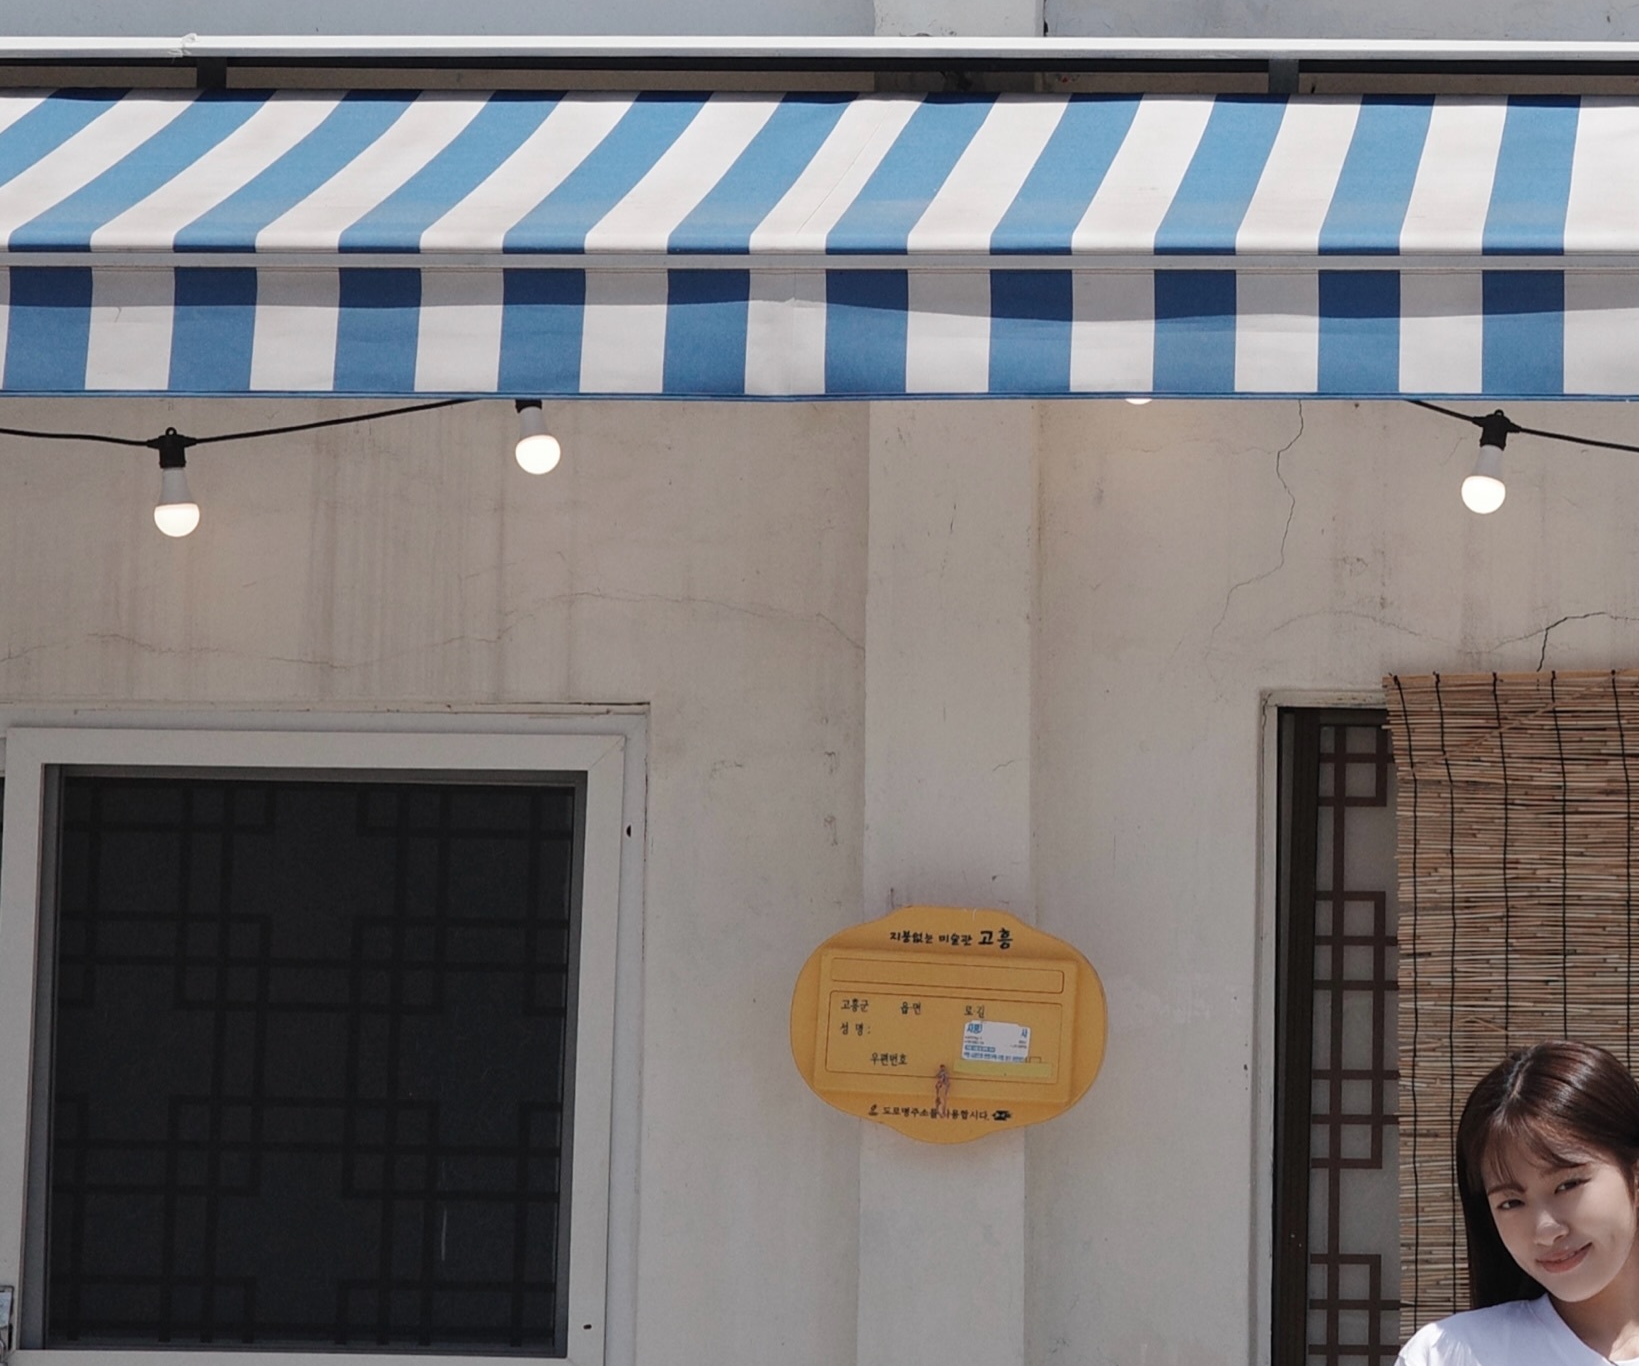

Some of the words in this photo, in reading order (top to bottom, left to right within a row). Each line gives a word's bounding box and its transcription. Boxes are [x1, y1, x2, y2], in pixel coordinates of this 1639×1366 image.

[890, 930, 933, 944] 지붕없는
[938, 933, 973, 946] 미술관
[978, 928, 1013, 950] 고흥
[840, 998, 869, 1012] 고흥군
[870, 1052, 907, 1067] 우편번호
[882, 1106, 938, 1119] 도로명주소를
